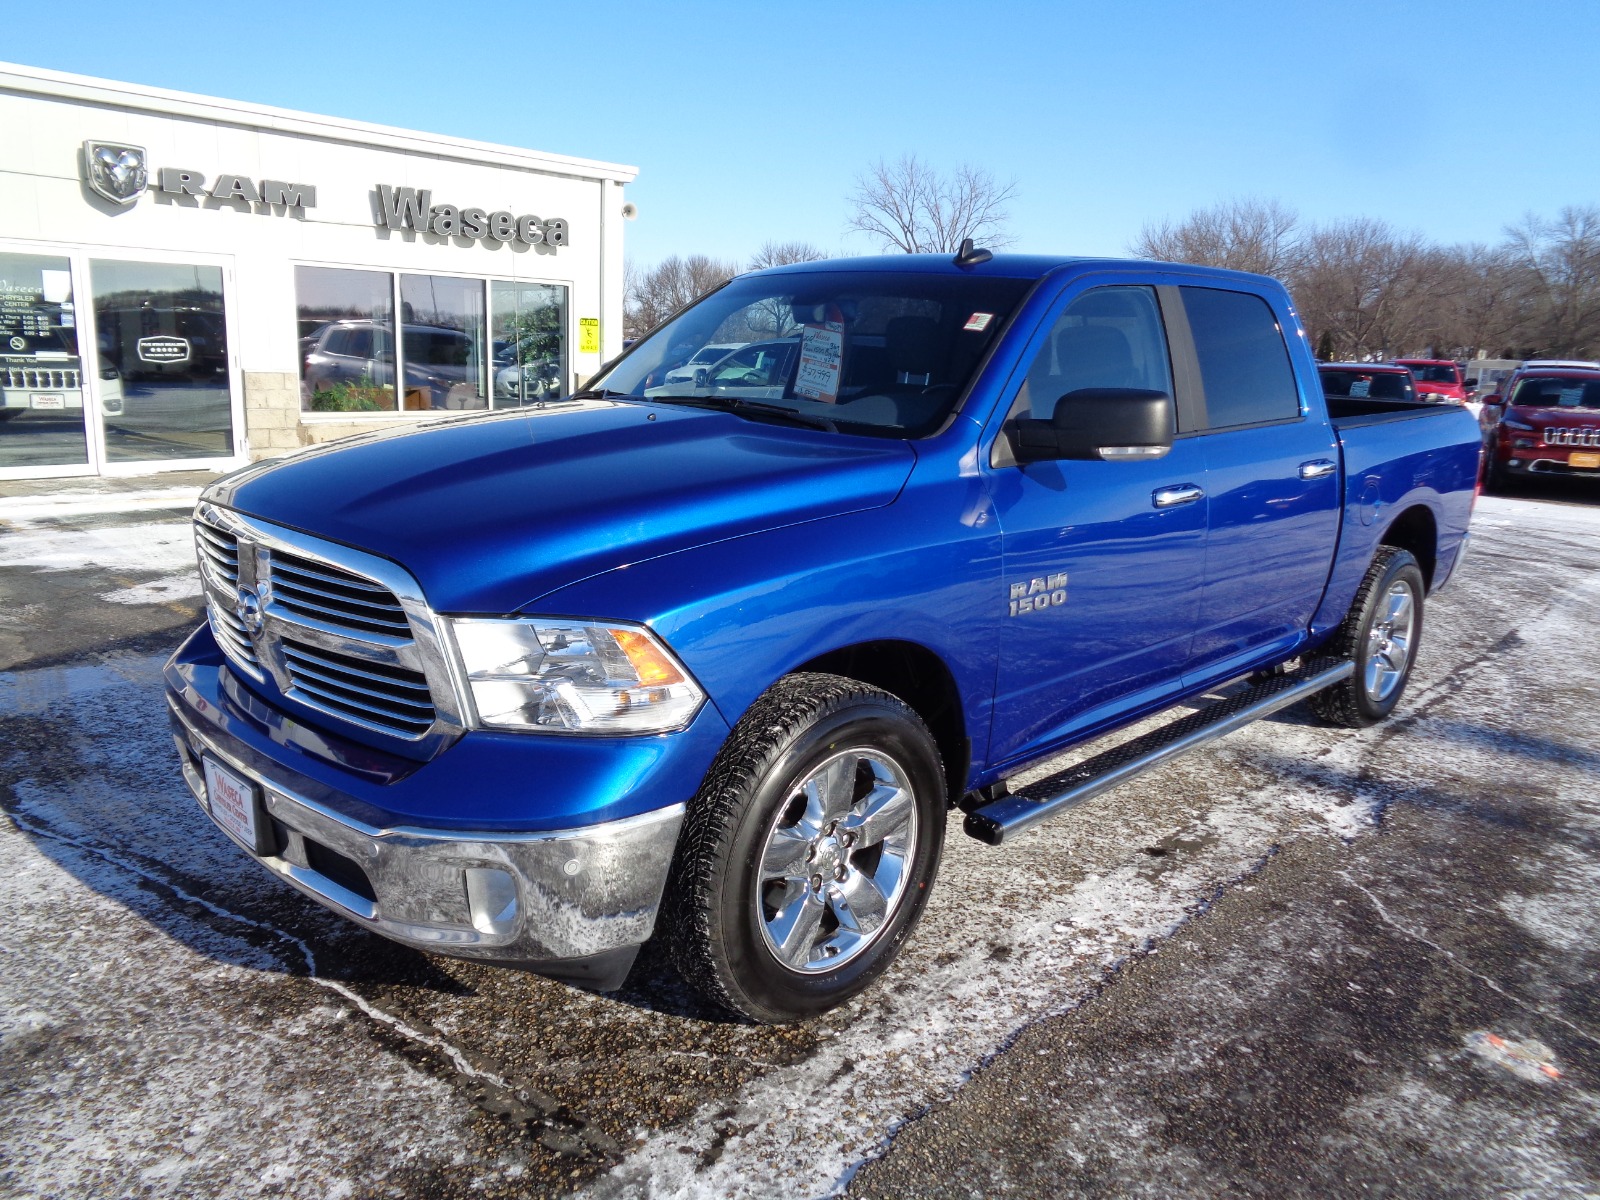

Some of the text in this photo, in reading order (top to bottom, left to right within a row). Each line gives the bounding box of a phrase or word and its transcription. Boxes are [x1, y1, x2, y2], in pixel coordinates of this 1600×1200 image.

[157, 167, 317, 208] RAM
[376, 184, 569, 248] Waseca
[1008, 589, 1067, 617] 1500
[1009, 571, 1068, 600] RAM
[214, 771, 243, 808] WASECA
